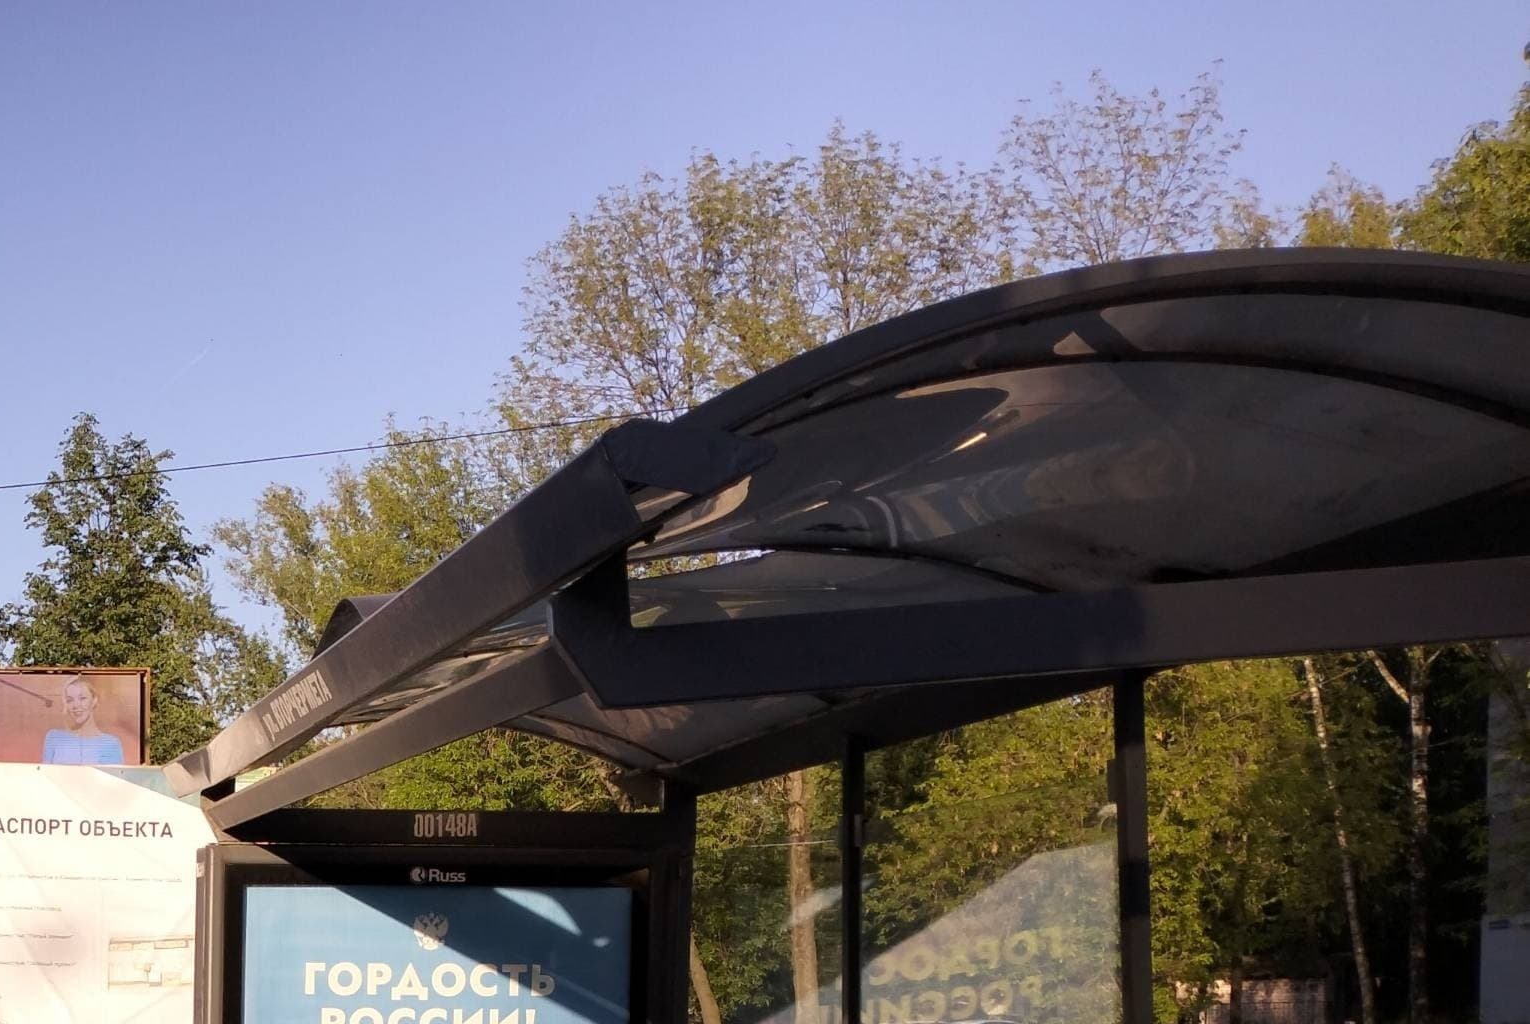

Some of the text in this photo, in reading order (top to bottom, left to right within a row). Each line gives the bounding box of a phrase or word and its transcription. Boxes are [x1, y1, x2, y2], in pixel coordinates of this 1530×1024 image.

[79, 819, 174, 838] ОБЪЕКТА
[414, 813, 478, 838] 00148A
[428, 868, 466, 883] Russ
[304, 961, 556, 1001] ГОРДОСТЬ
